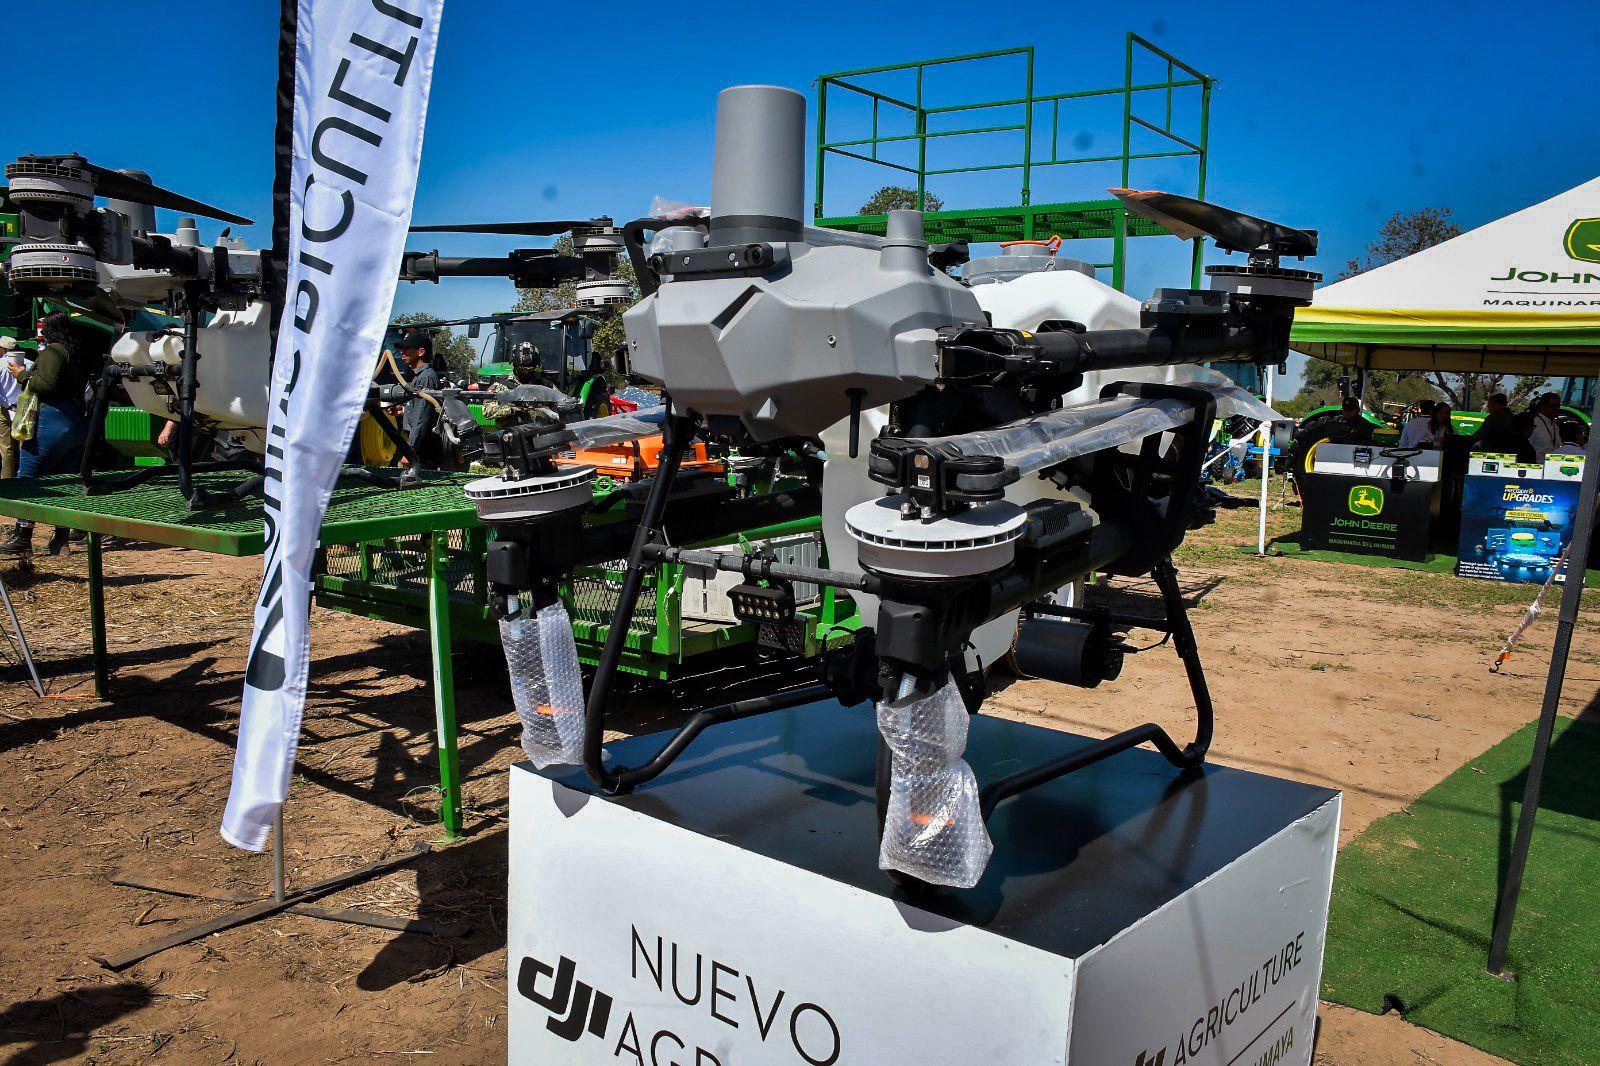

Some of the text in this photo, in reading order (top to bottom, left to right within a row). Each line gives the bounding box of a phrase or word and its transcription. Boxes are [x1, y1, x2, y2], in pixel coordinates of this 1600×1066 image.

[1330, 517, 1398, 531] JOHN DEERE
[1502, 493, 1555, 504] UPGRADES
[631, 922, 842, 1066] NUEVO
[1173, 931, 1305, 1066] AGRICULTURE
